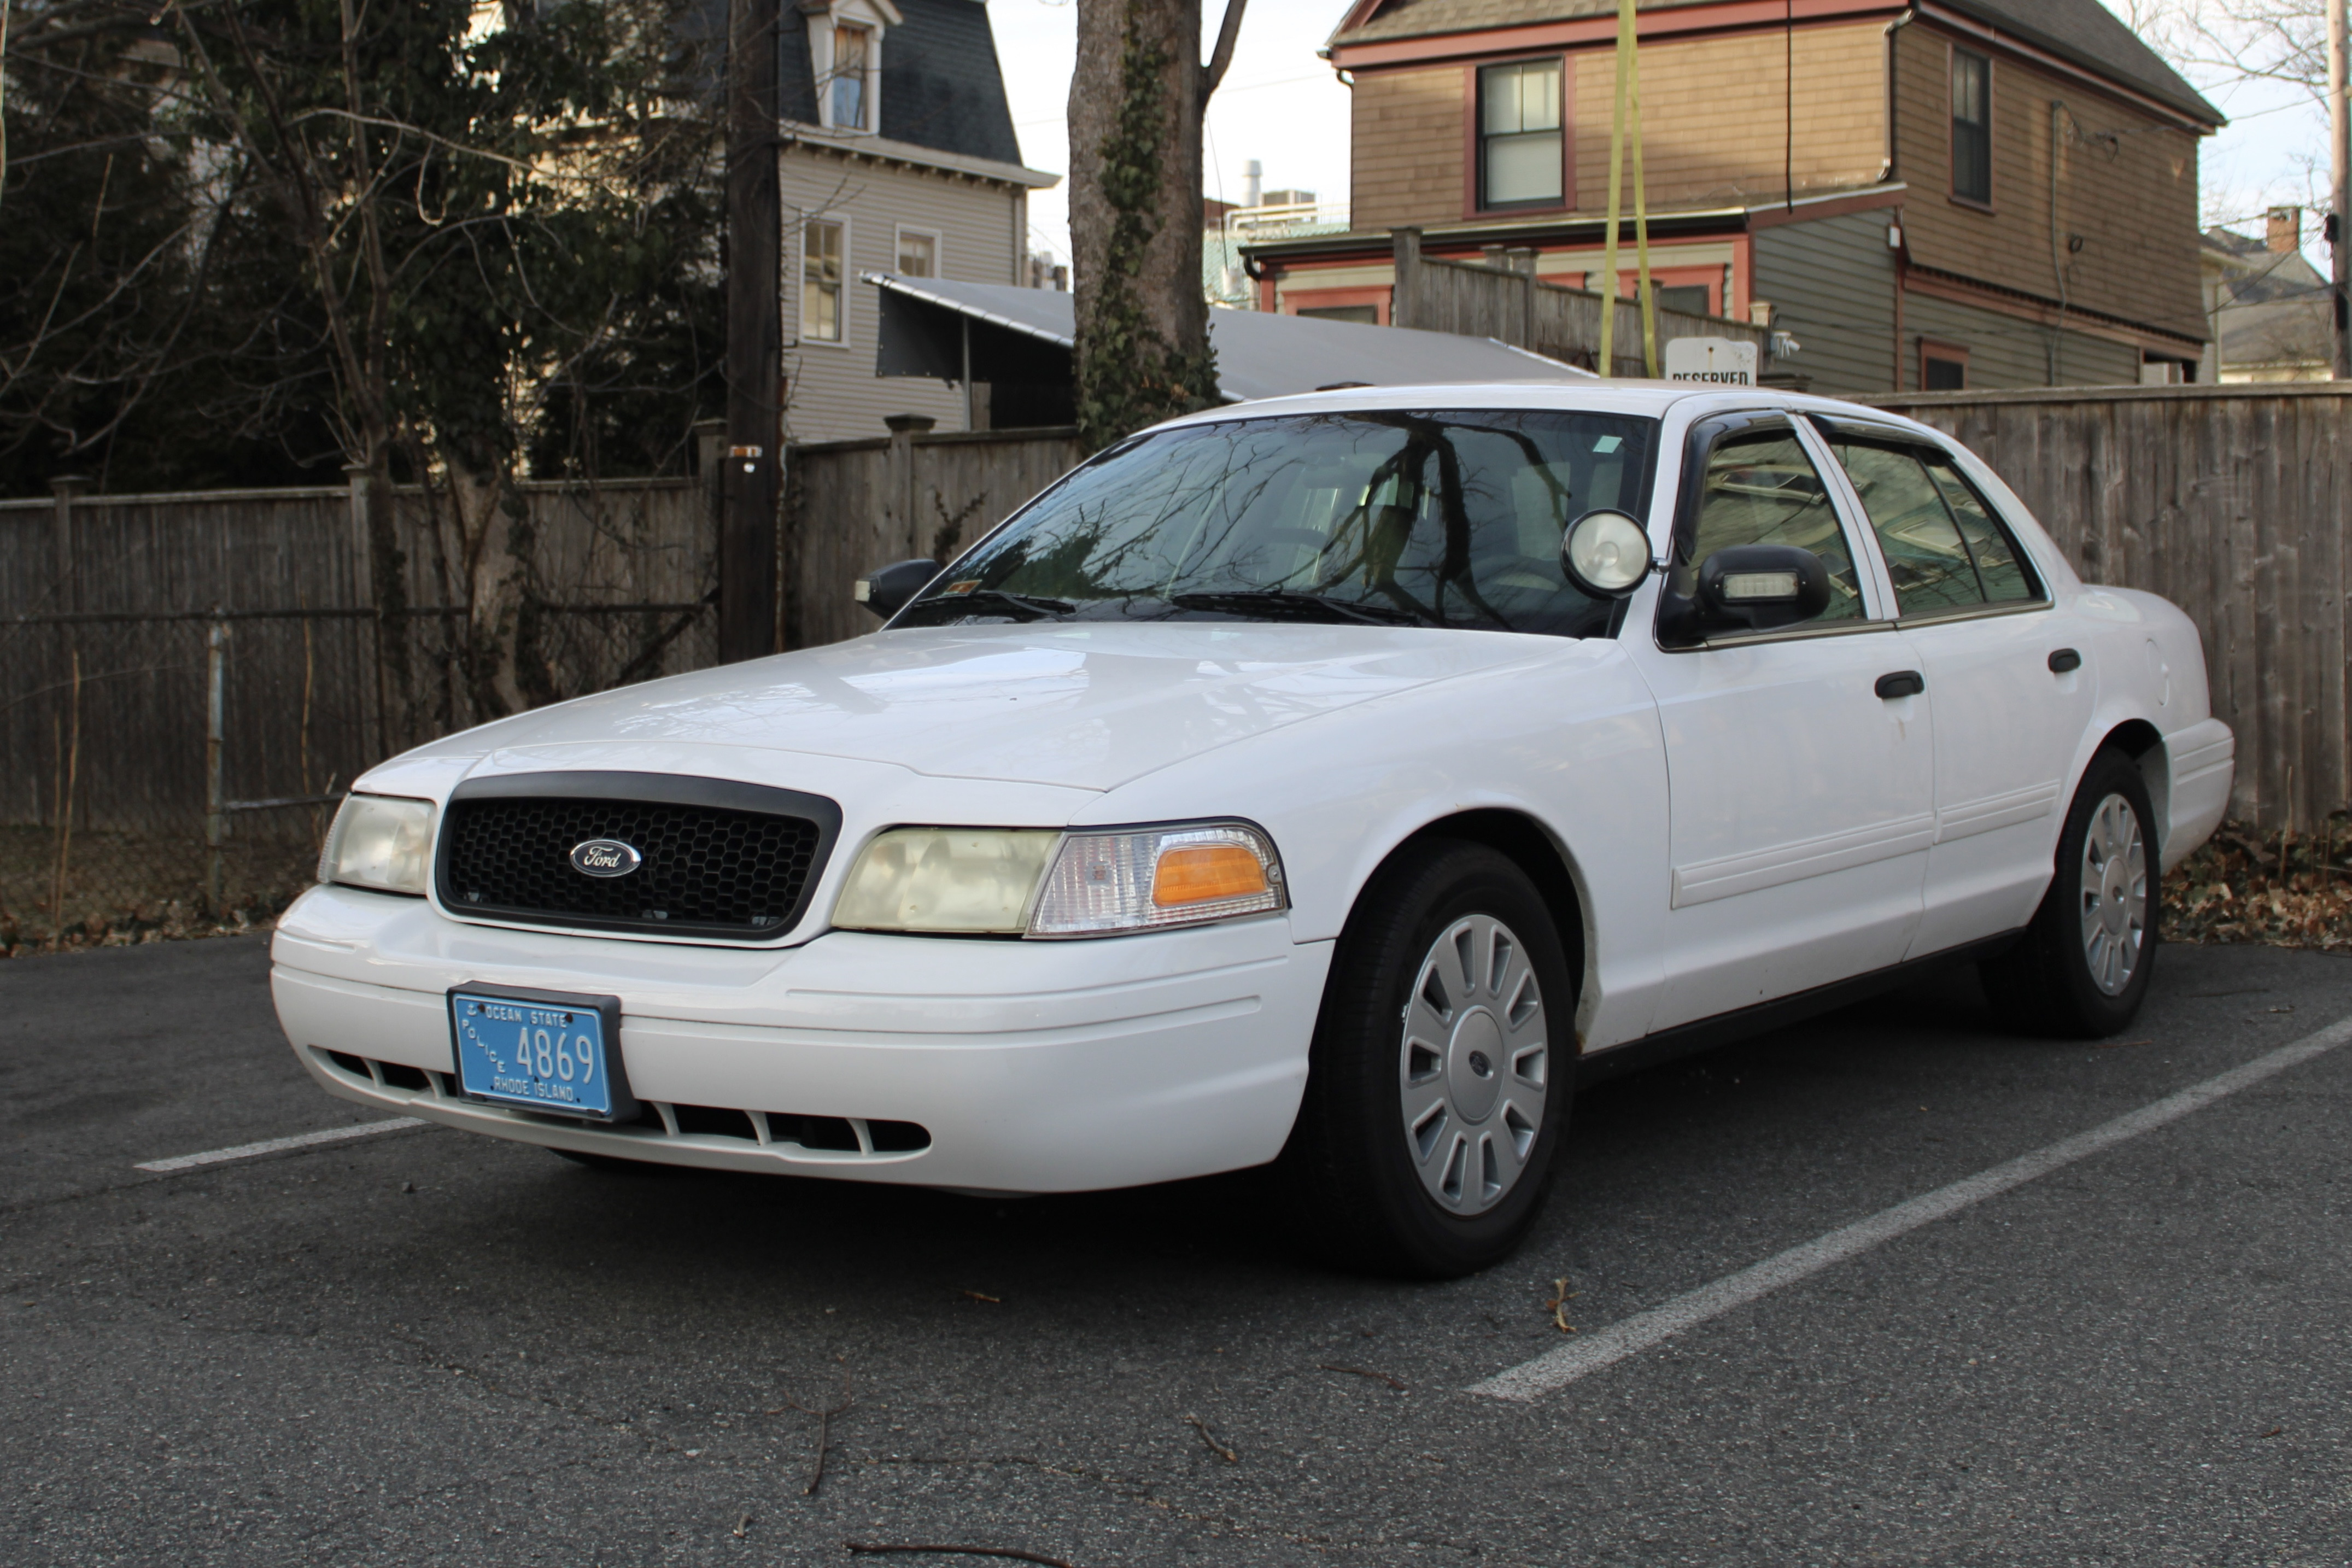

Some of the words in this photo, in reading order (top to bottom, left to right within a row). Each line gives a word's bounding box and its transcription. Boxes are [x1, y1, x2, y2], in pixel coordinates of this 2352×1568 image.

[584, 846, 621, 868] Ford
[486, 1006, 522, 1022] OCEAN
[530, 1011, 567, 1028] STATE
[462, 1020, 506, 1073] POLICE
[517, 1027, 594, 1084] 4869
[494, 1076, 530, 1095] RHODE
[534, 1081, 574, 1102] ISLAND
